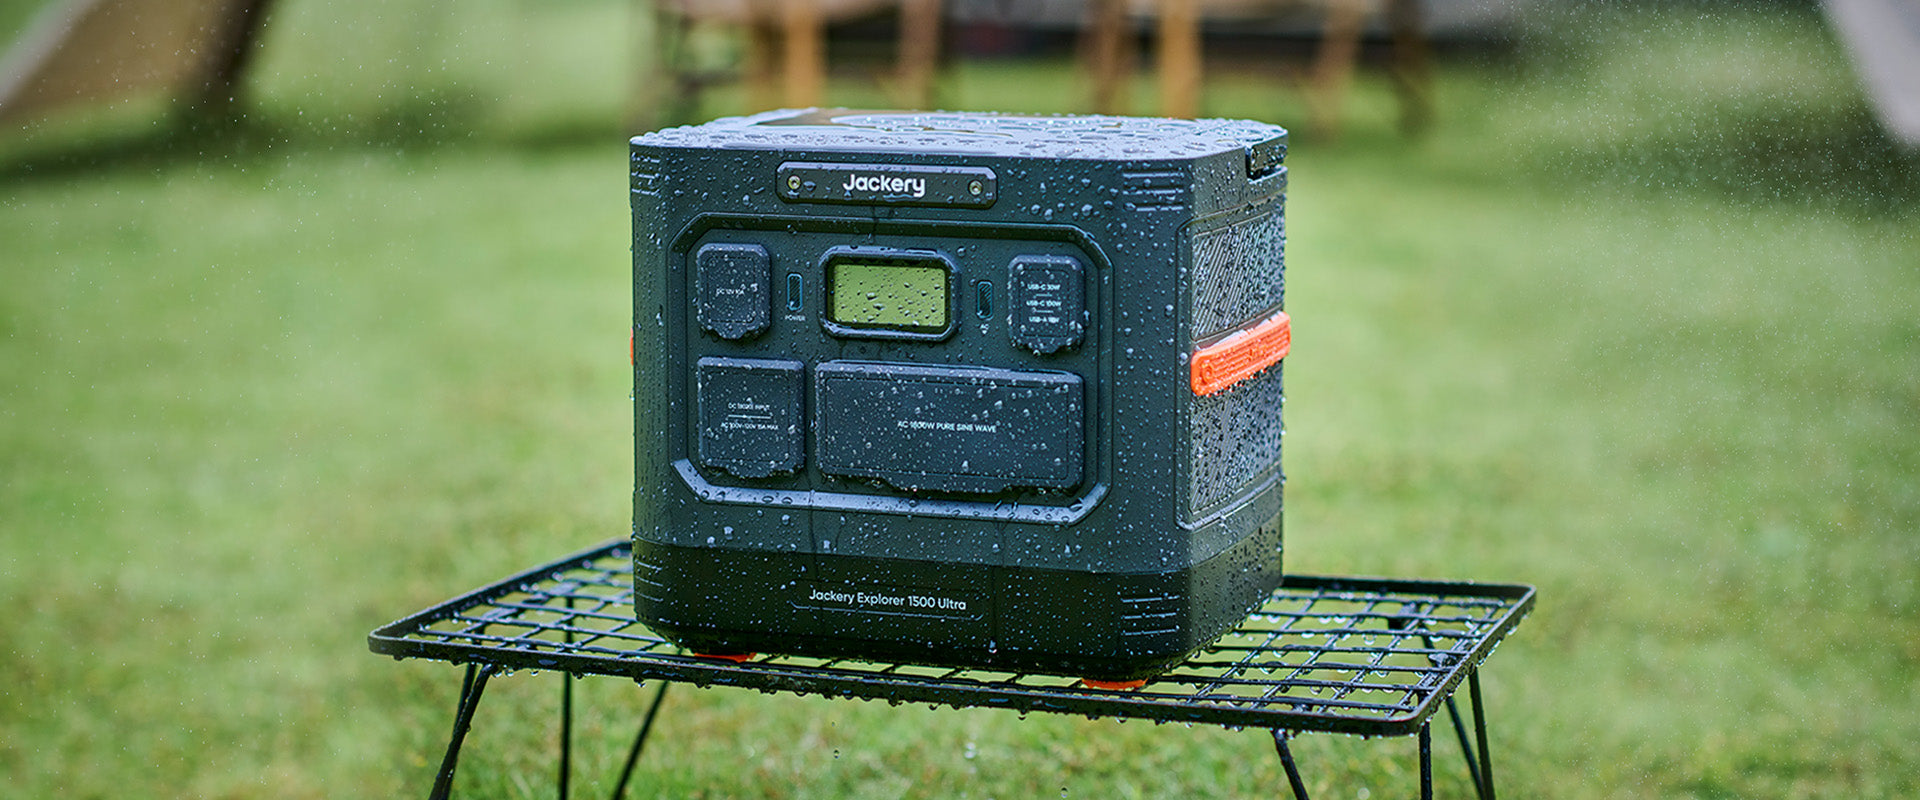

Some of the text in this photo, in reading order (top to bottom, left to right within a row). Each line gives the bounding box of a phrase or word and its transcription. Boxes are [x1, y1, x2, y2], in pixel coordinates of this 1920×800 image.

[842, 173, 925, 198] Jackery
[897, 421, 909, 429] AC
[936, 422, 955, 431] PURE
[956, 423, 973, 431] SINE
[974, 424, 997, 433] WAVE
[809, 589, 967, 610] Jackery Explorer 1500 Ultra
